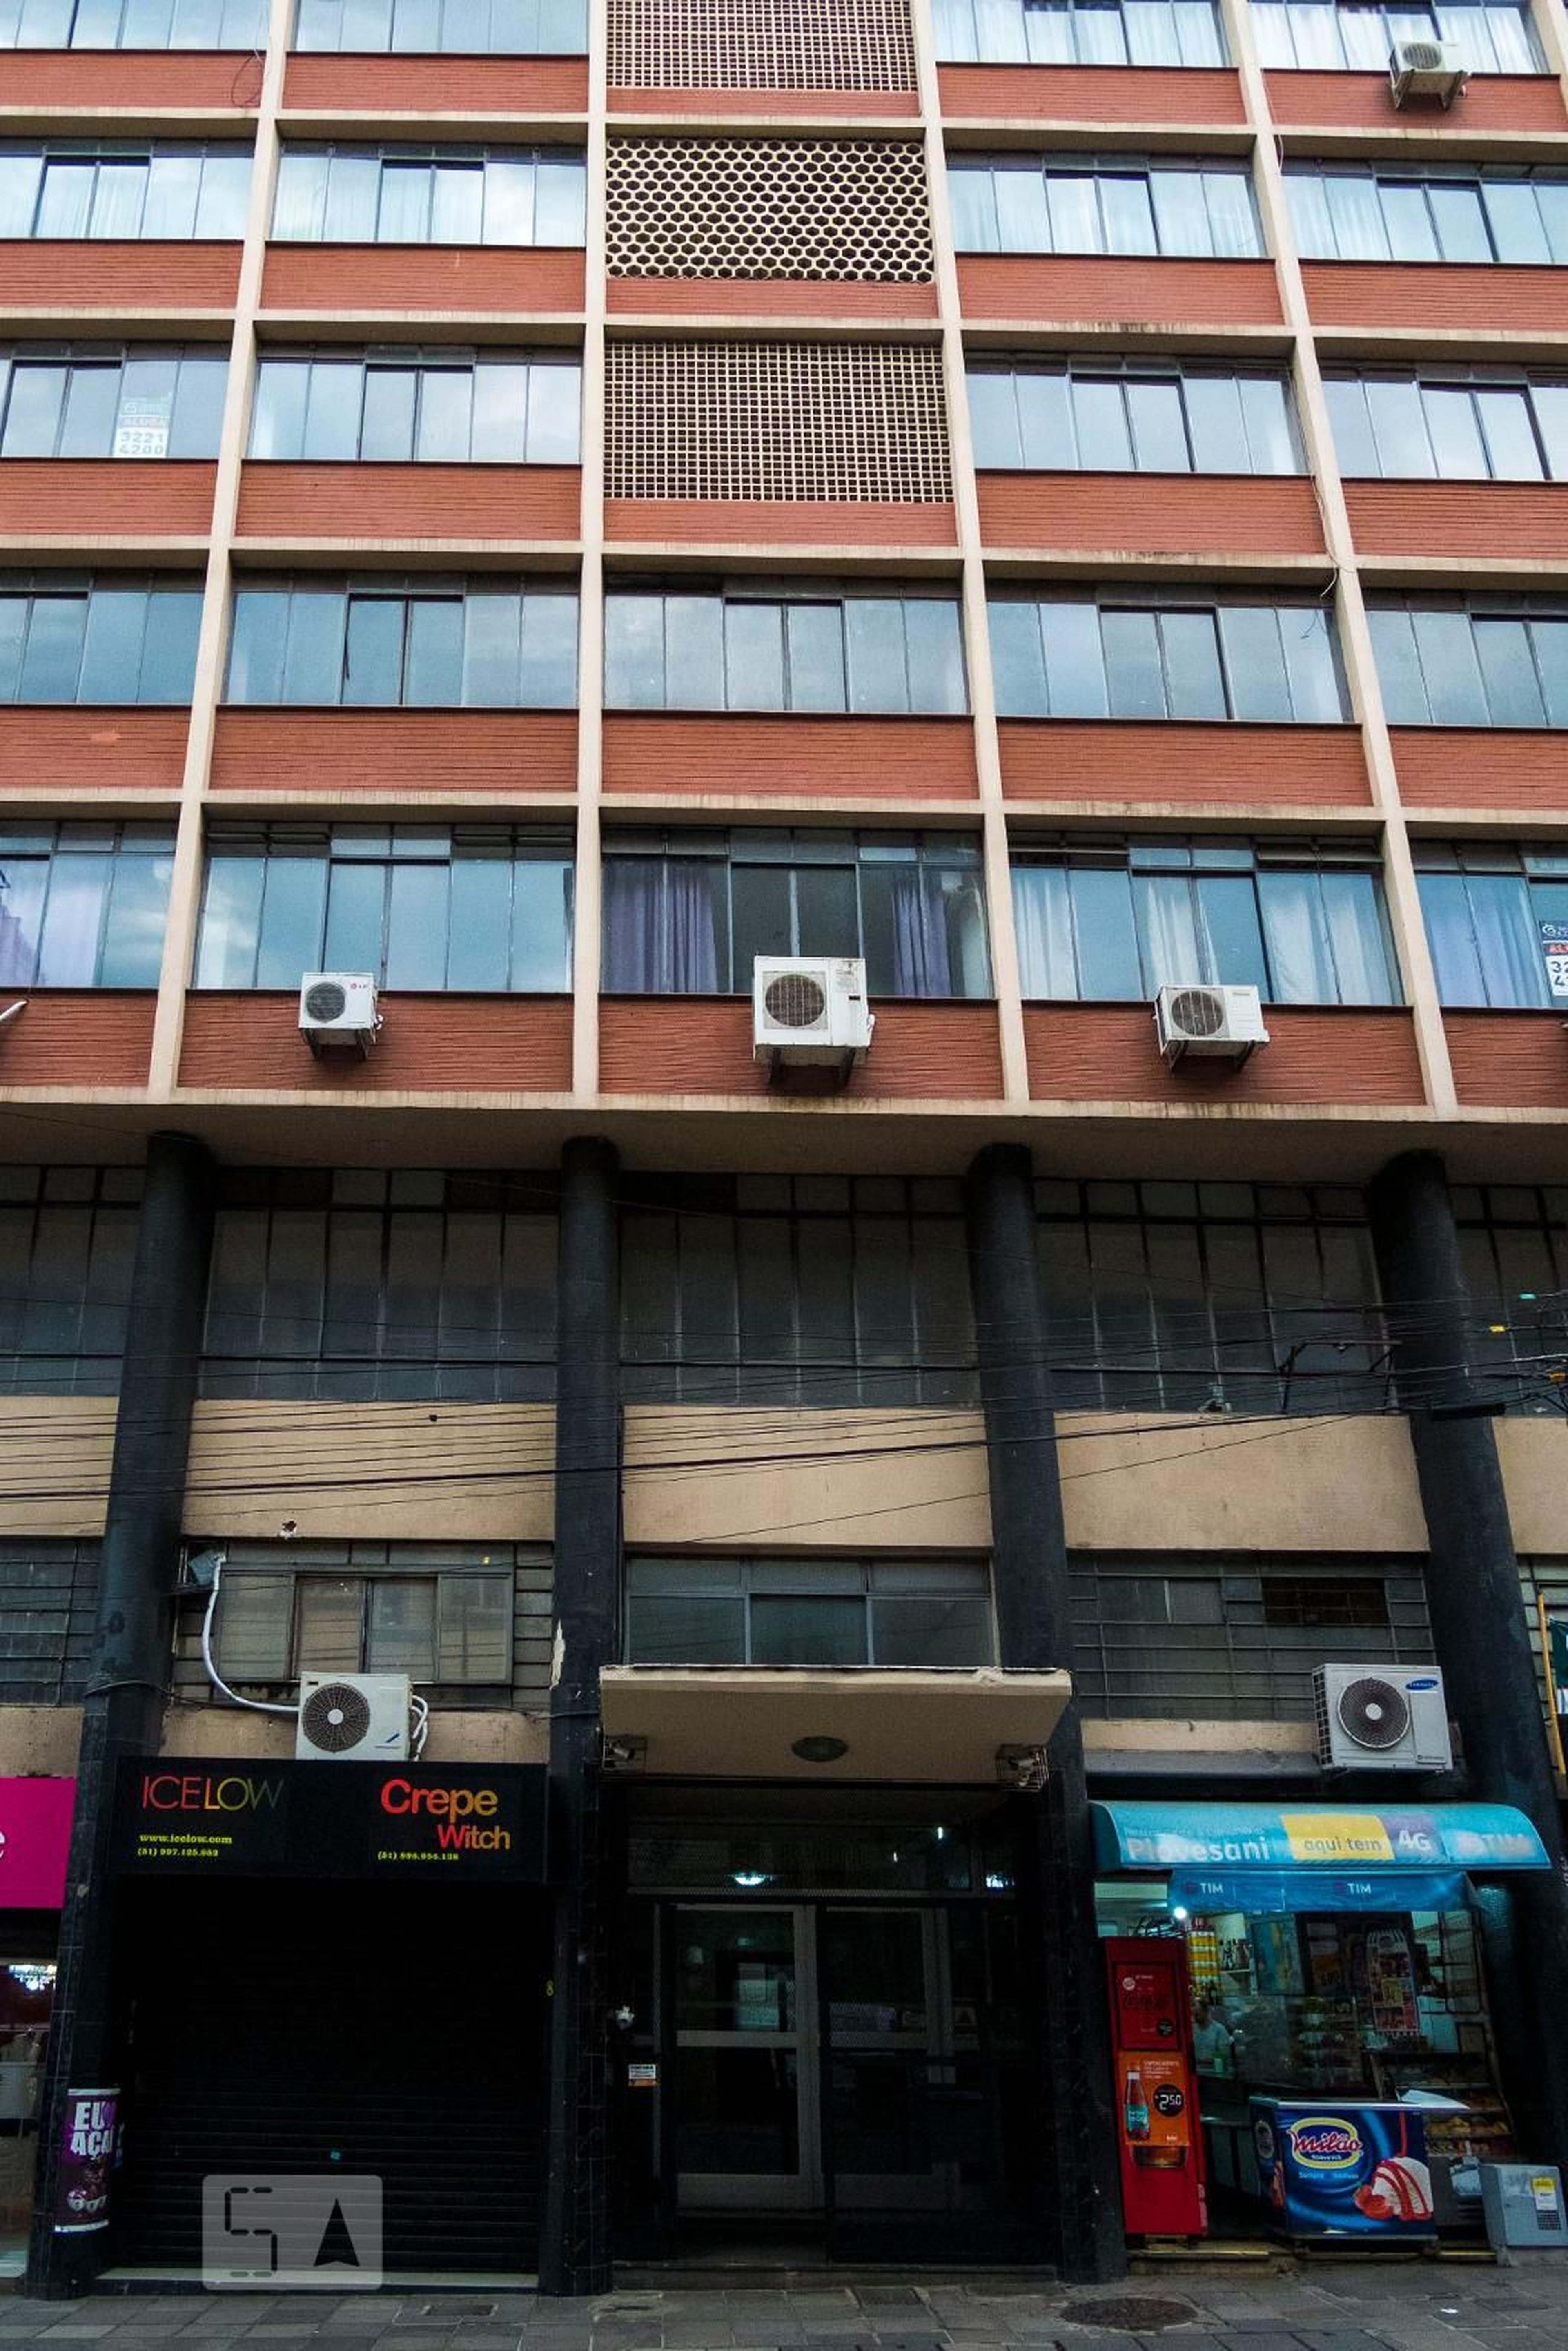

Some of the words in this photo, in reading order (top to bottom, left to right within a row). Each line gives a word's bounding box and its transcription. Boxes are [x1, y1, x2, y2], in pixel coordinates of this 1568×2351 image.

[121, 431, 163, 443] 3221
[141, 1775, 284, 1811] ICELOW
[381, 1778, 499, 1824] Crepe
[139, 1833, 232, 1845] www.icelow.com
[437, 1825, 510, 1850] Witch
[1304, 1836, 1342, 1855] aqui
[1347, 1837, 1382, 1851] tem
[1200, 1883, 1224, 1894] TIM
[1347, 1883, 1372, 1894] TIM
[74, 2102, 106, 2130] EU
